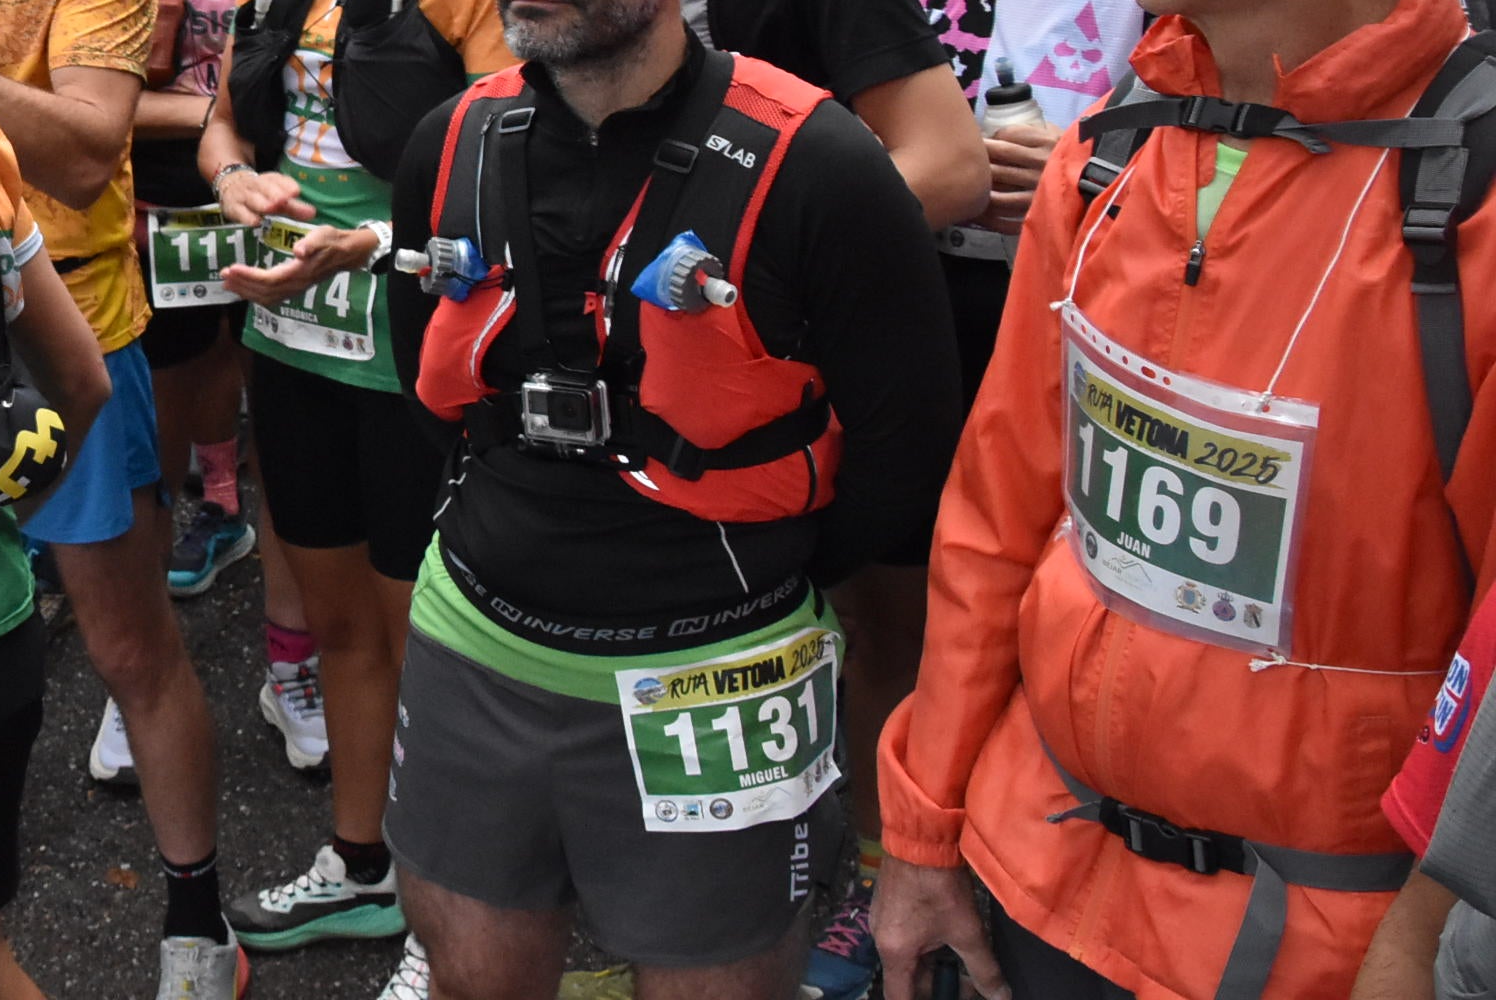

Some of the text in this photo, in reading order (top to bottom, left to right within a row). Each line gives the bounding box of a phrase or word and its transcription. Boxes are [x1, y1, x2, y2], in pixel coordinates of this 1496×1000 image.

[1115, 400, 1190, 460] VETONA
[1194, 442, 1281, 485] 2025
[1078, 422, 1241, 565] 1169
[1117, 531, 1151, 559] JUAN
[523, 615, 658, 641] INVERSE
[670, 673, 709, 699] RUTA
[712, 655, 787, 695] VETONA
[663, 678, 819, 777] 1131
[739, 766, 789, 788] MIGUEL
